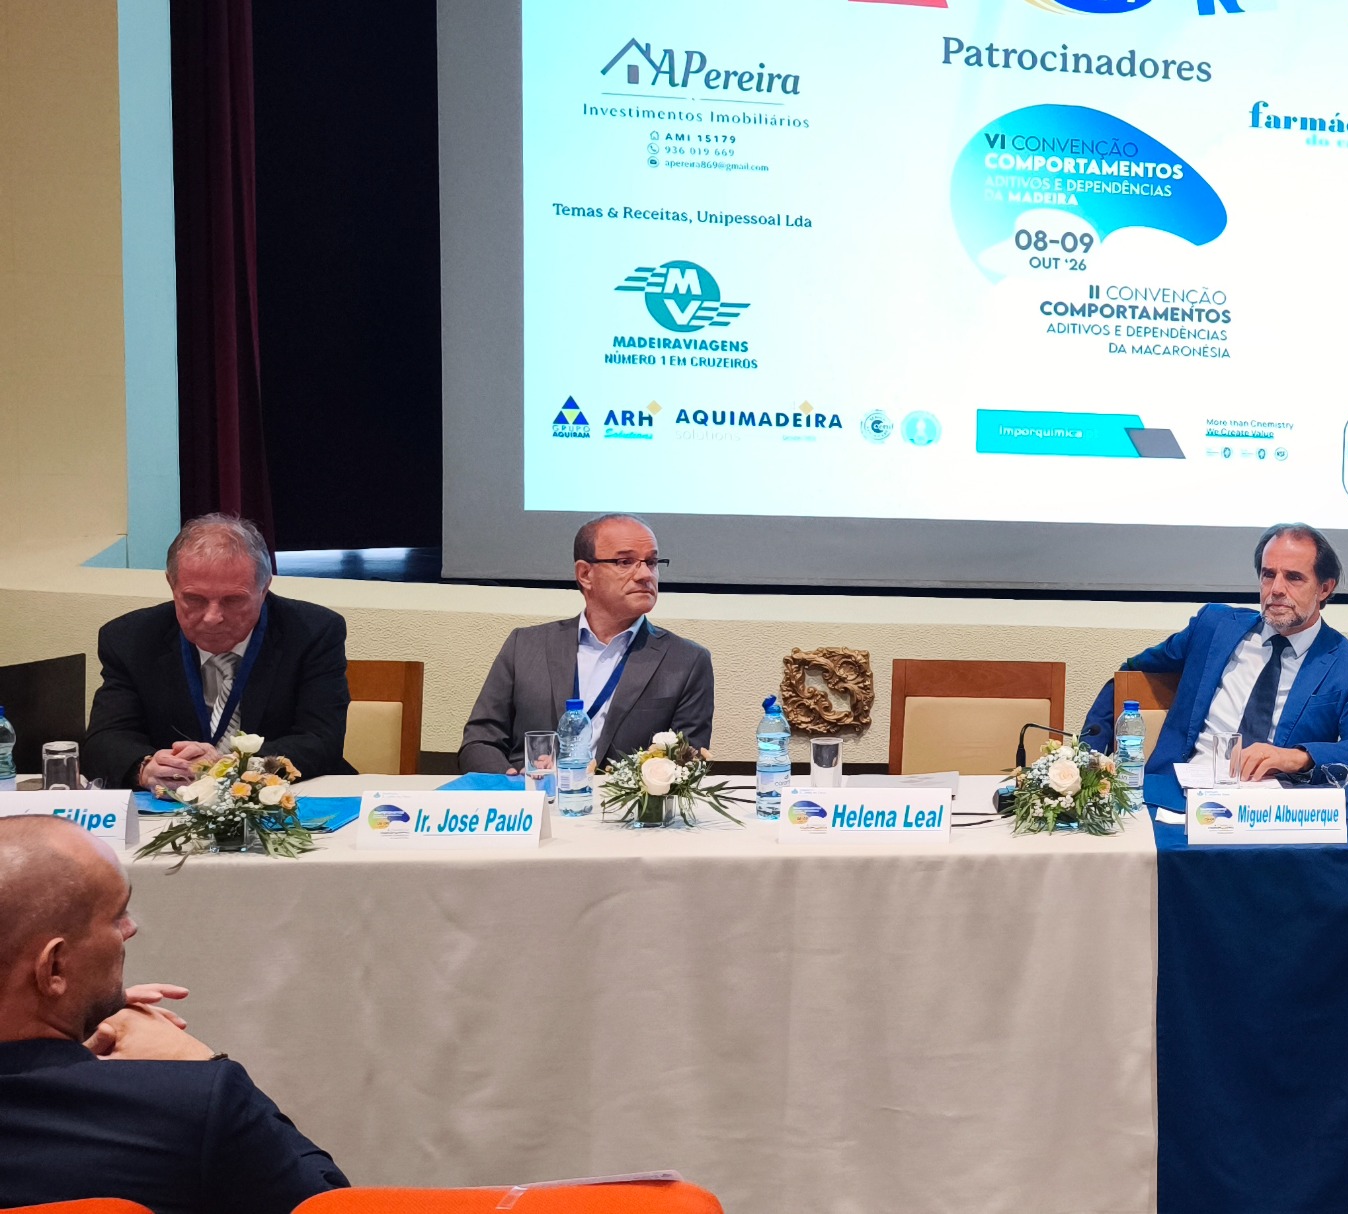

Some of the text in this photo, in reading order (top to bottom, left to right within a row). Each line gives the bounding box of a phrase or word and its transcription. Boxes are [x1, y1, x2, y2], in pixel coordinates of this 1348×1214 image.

[942, 36, 1213, 83] Patrocinadores
[583, 103, 810, 129] Investimentos Imobiliários
[665, 132, 736, 144] AMI 15179
[984, 133, 1139, 160] VI CONVENÇÃO
[984, 152, 1184, 181] COMPORTAMENTOS
[985, 175, 1172, 198] ADITIVOS E DEPENDÊNCIAS
[985, 188, 1079, 206] DA MADEIRA
[553, 203, 812, 228] Temas & Receitas, Unipessoal Lda
[1015, 229, 1094, 254] 08-09
[1029, 256, 1060, 270] OUT
[1089, 284, 1227, 306] II CONVENÇÃO
[1039, 300, 1232, 324] COMPORTAMENTOS
[1046, 322, 1228, 342] ADITIVOS E DEPENDÊNCIAS
[612, 336, 749, 353] MADEIRAVIAGENS
[1108, 342, 1231, 359] DA MACARONÉSIA
[605, 350, 758, 369] NÚMERO 1 EM CRUZEIROS
[552, 424, 591, 432] GRUPO
[603, 409, 654, 427] ARH
[675, 408, 843, 429] AQUIMADEIRA
[1206, 418, 1228, 427] More
[552, 431, 591, 439] AQUIRAM
[414, 808, 431, 833] Ir.
[437, 807, 480, 833] José
[484, 807, 533, 833] Paulo
[831, 804, 897, 828] Helena
[903, 804, 944, 828] Leal
[1237, 804, 1272, 828] Miguel
[1275, 804, 1339, 829] Albuquerque
